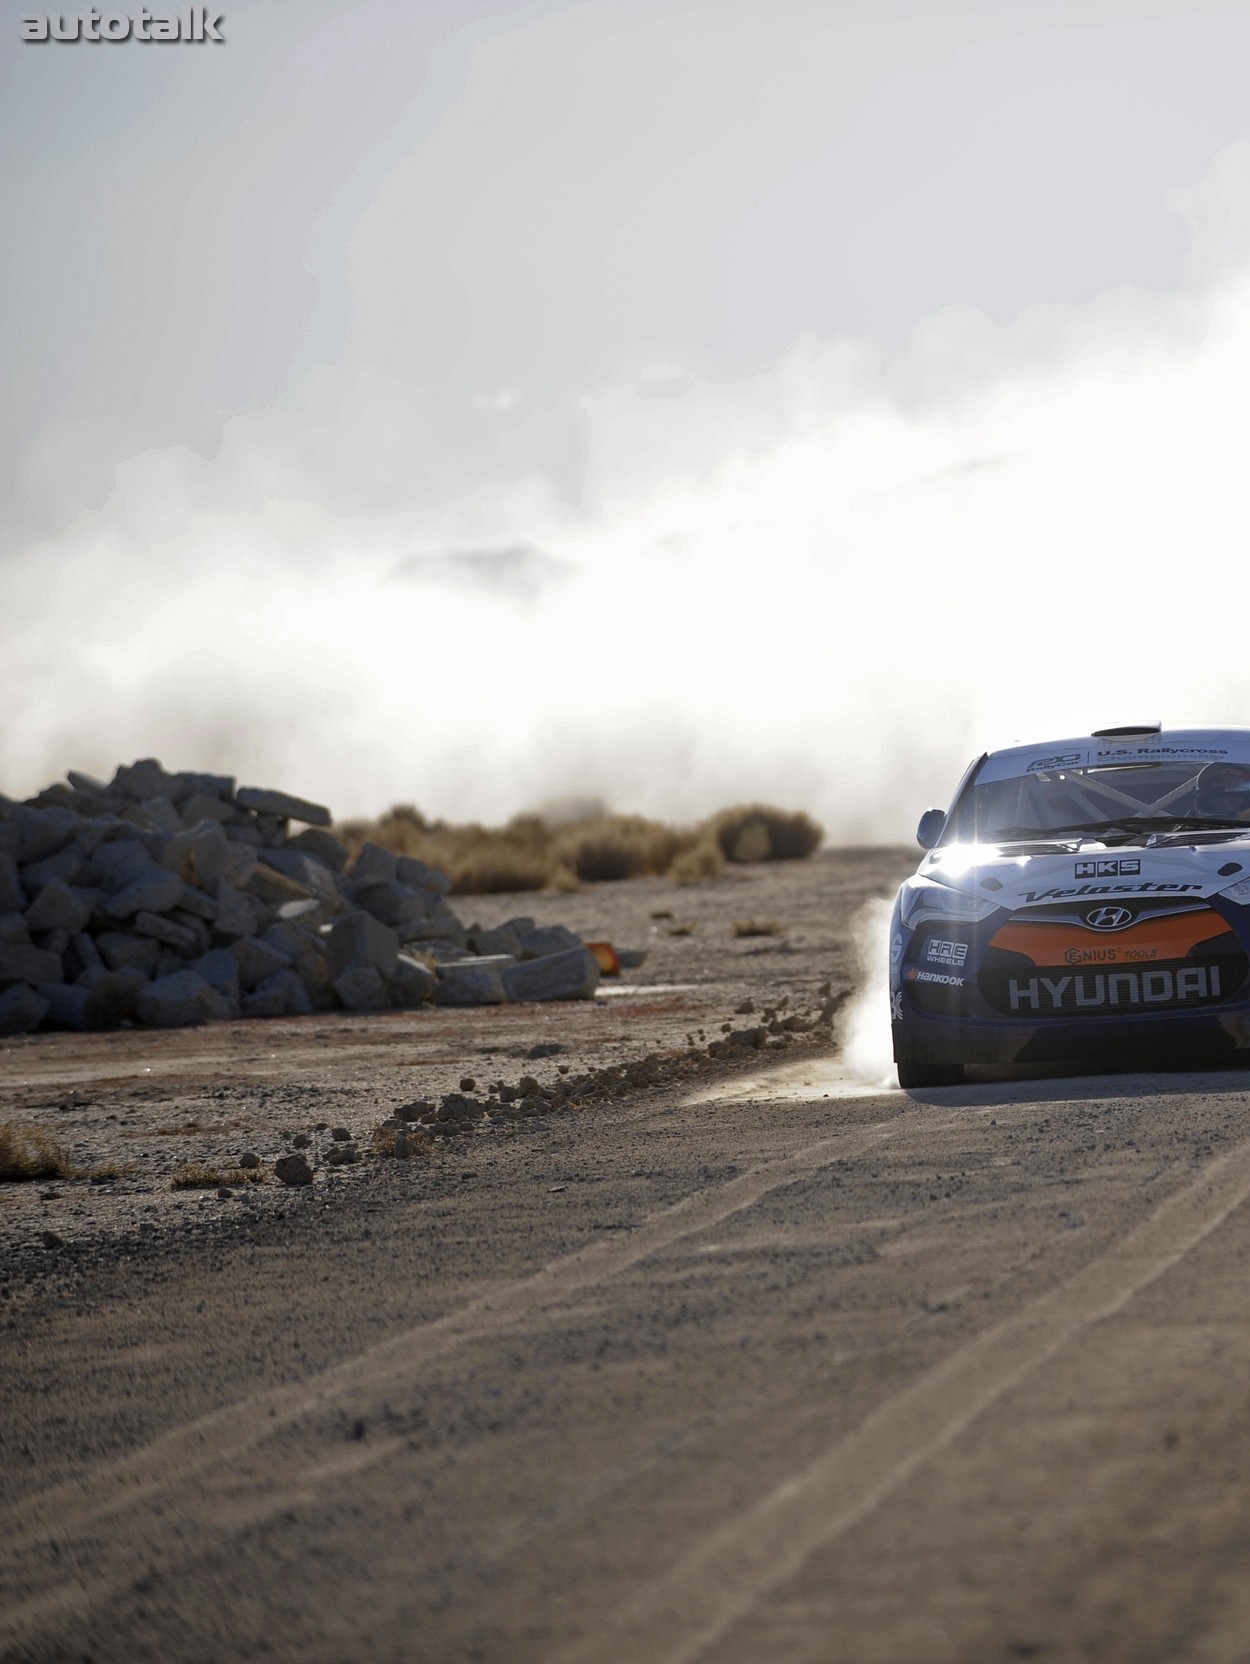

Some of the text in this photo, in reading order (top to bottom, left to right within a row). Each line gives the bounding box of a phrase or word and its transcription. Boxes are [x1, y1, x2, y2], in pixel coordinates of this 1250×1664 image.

[1137, 748, 1228, 756] Rallycross
[1075, 859, 1141, 879] HKS
[1018, 882, 1203, 903] Veloster
[928, 939, 969, 960] HRE
[1124, 948, 1158, 960] TOOLS
[926, 955, 965, 967] WHEELS
[1009, 965, 1220, 1010] HYUNDAI
